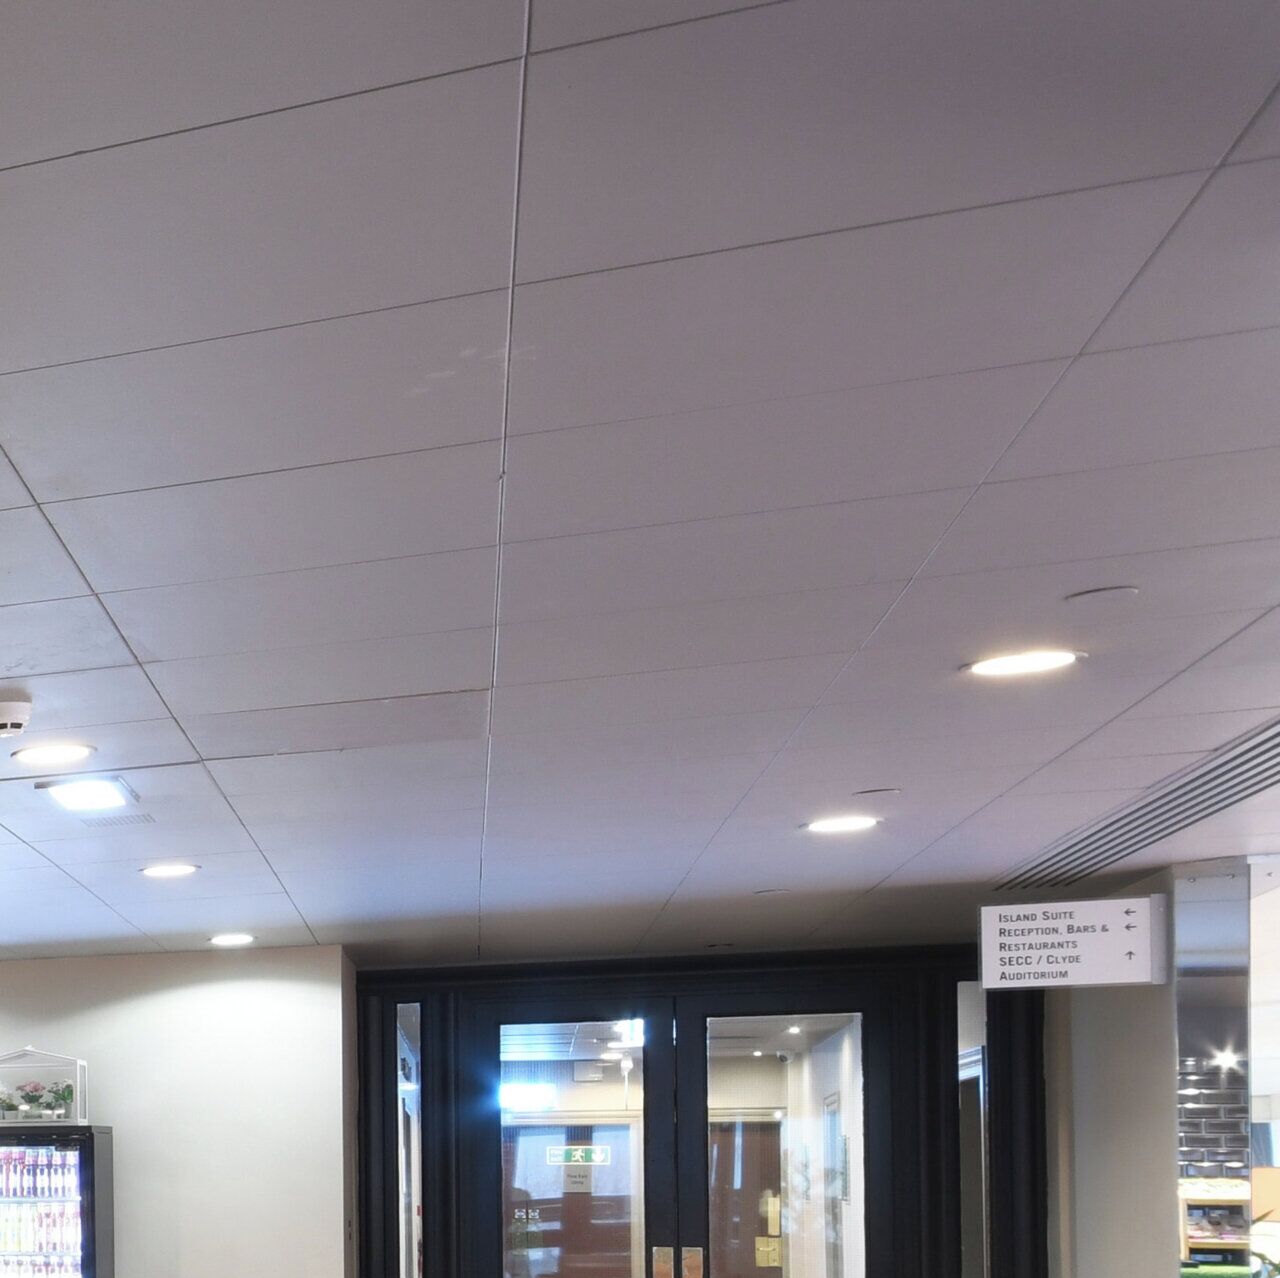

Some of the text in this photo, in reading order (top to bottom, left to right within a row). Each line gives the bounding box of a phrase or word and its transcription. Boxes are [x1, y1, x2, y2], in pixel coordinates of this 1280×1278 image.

[998, 910, 1075, 923] ISLAND SUITE
[1066, 924, 1097, 934] BARS
[1101, 924, 1109, 933] &
[998, 940, 1078, 952] RESTAURANTS
[999, 954, 1082, 966] SECC / CLYDE
[999, 970, 1069, 981] AUDITORIUM
